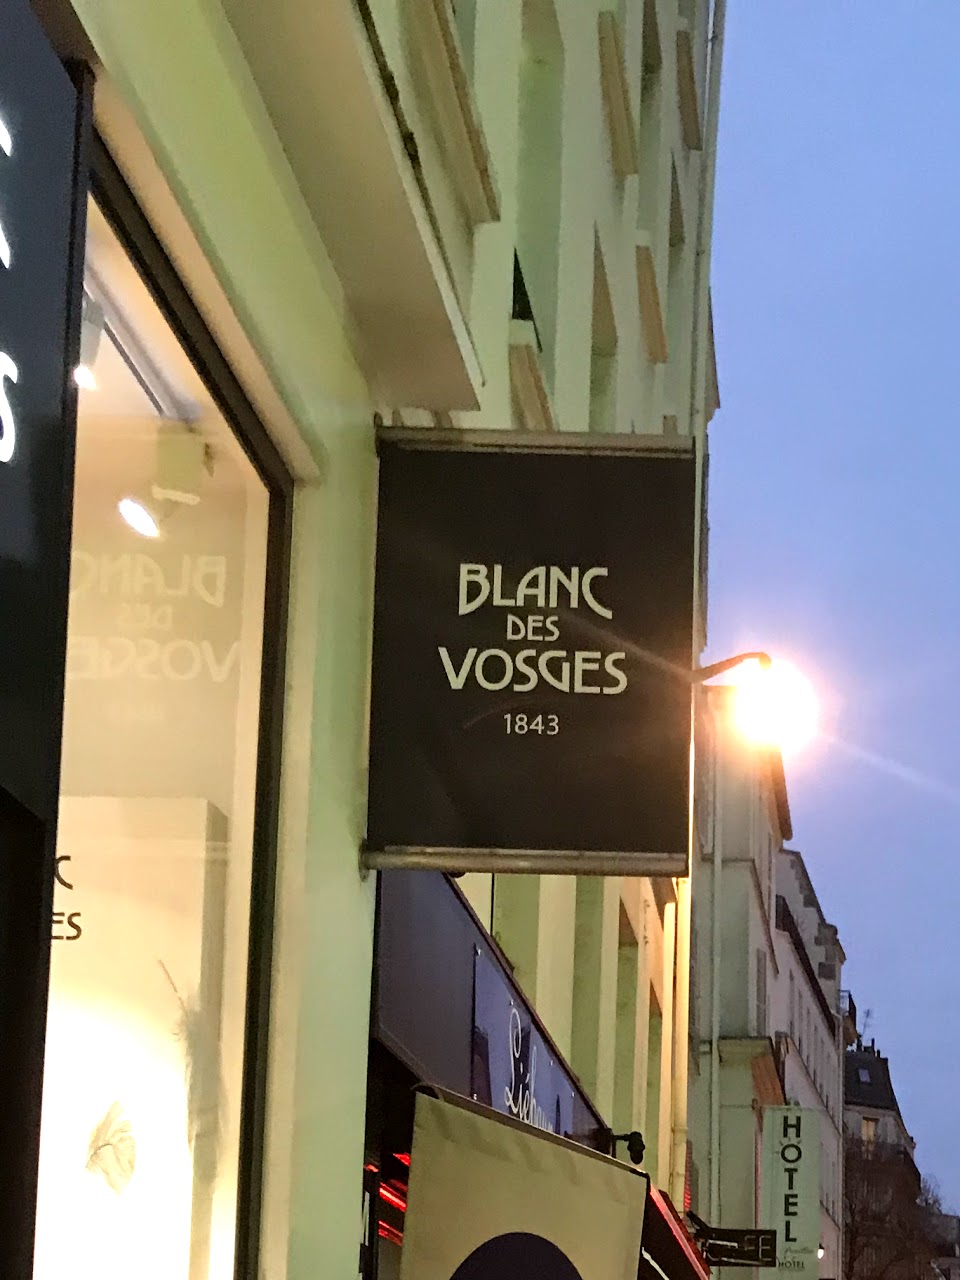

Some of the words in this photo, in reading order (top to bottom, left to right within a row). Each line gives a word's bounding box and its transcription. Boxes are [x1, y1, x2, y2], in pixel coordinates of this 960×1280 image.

[458, 563, 613, 620] BLANC
[506, 613, 560, 642] DES
[438, 646, 628, 695] VOSGES
[503, 712, 560, 735] 1843
[780, 1115, 802, 1243] HOTEL
